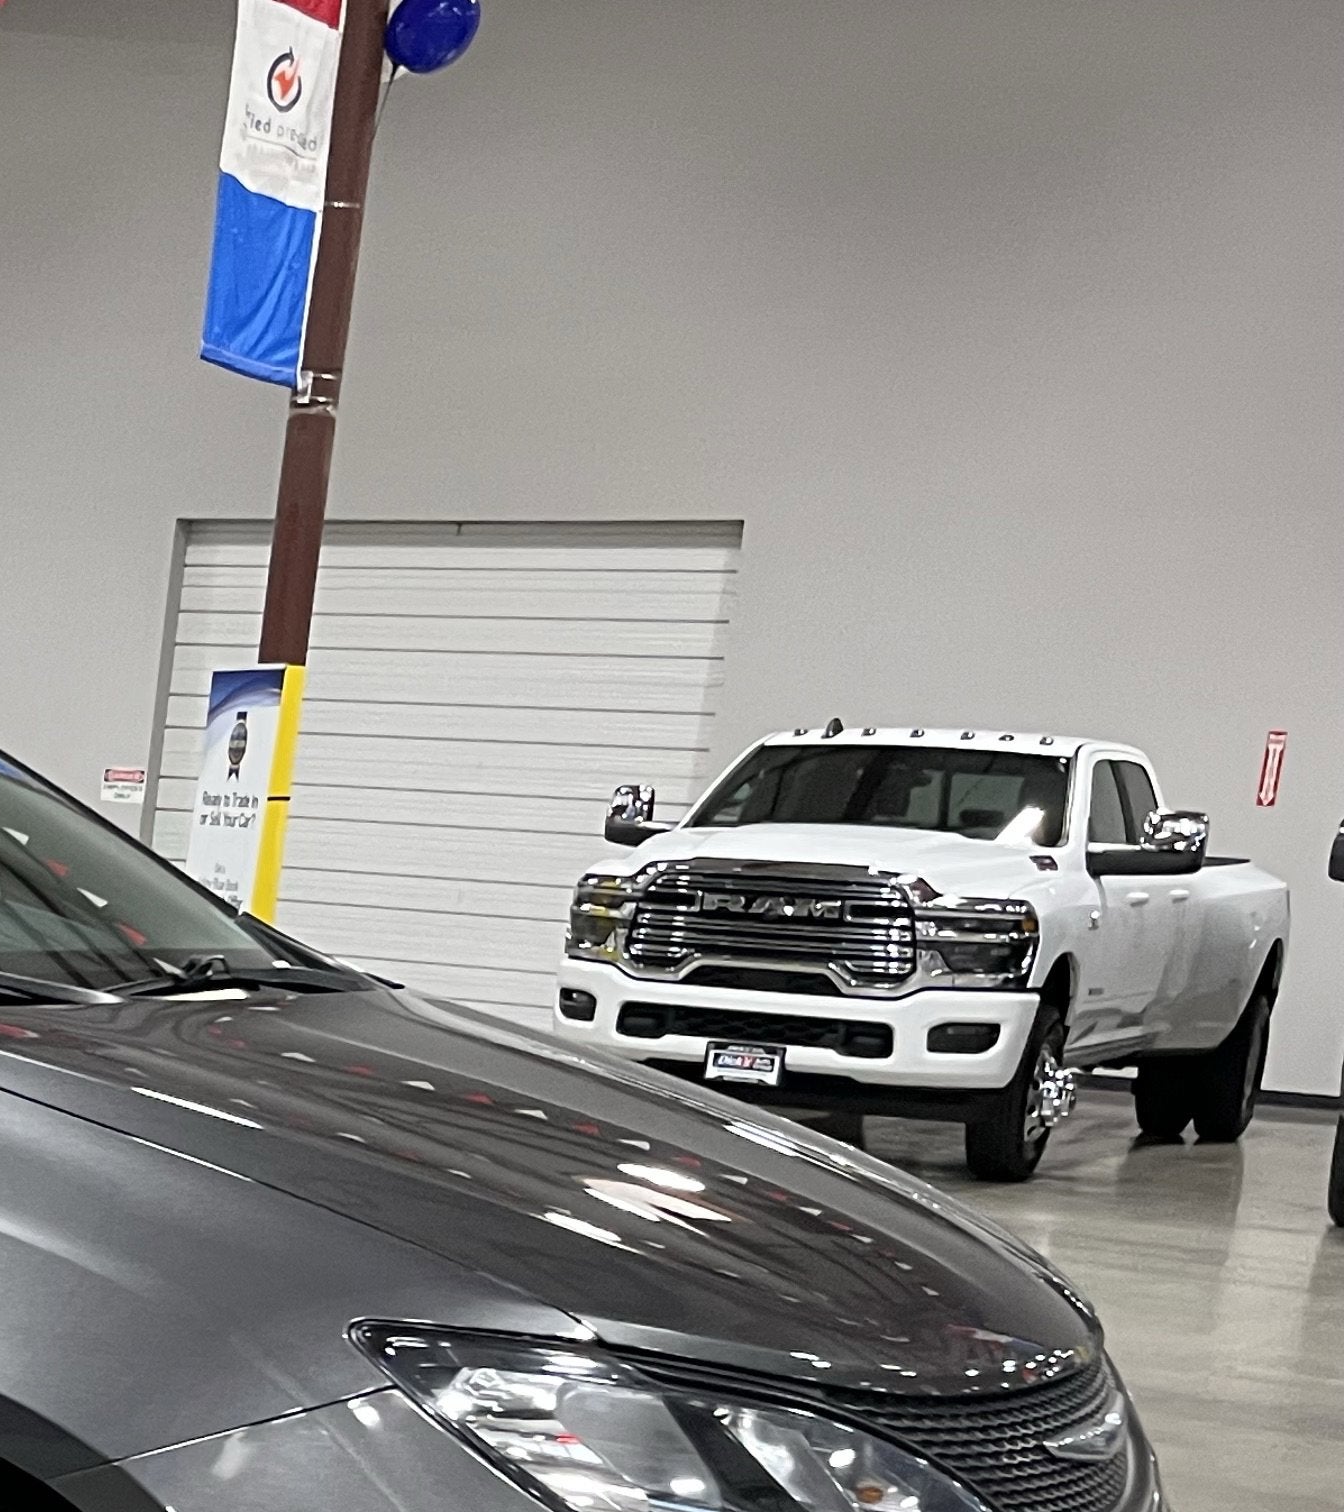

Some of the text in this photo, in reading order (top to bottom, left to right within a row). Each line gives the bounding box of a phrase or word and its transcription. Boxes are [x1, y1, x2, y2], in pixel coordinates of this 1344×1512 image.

[232, 792, 250, 808] Trade
[210, 811, 221, 826] Sell
[238, 813, 256, 828] Car?
[703, 893, 839, 918] RAM
